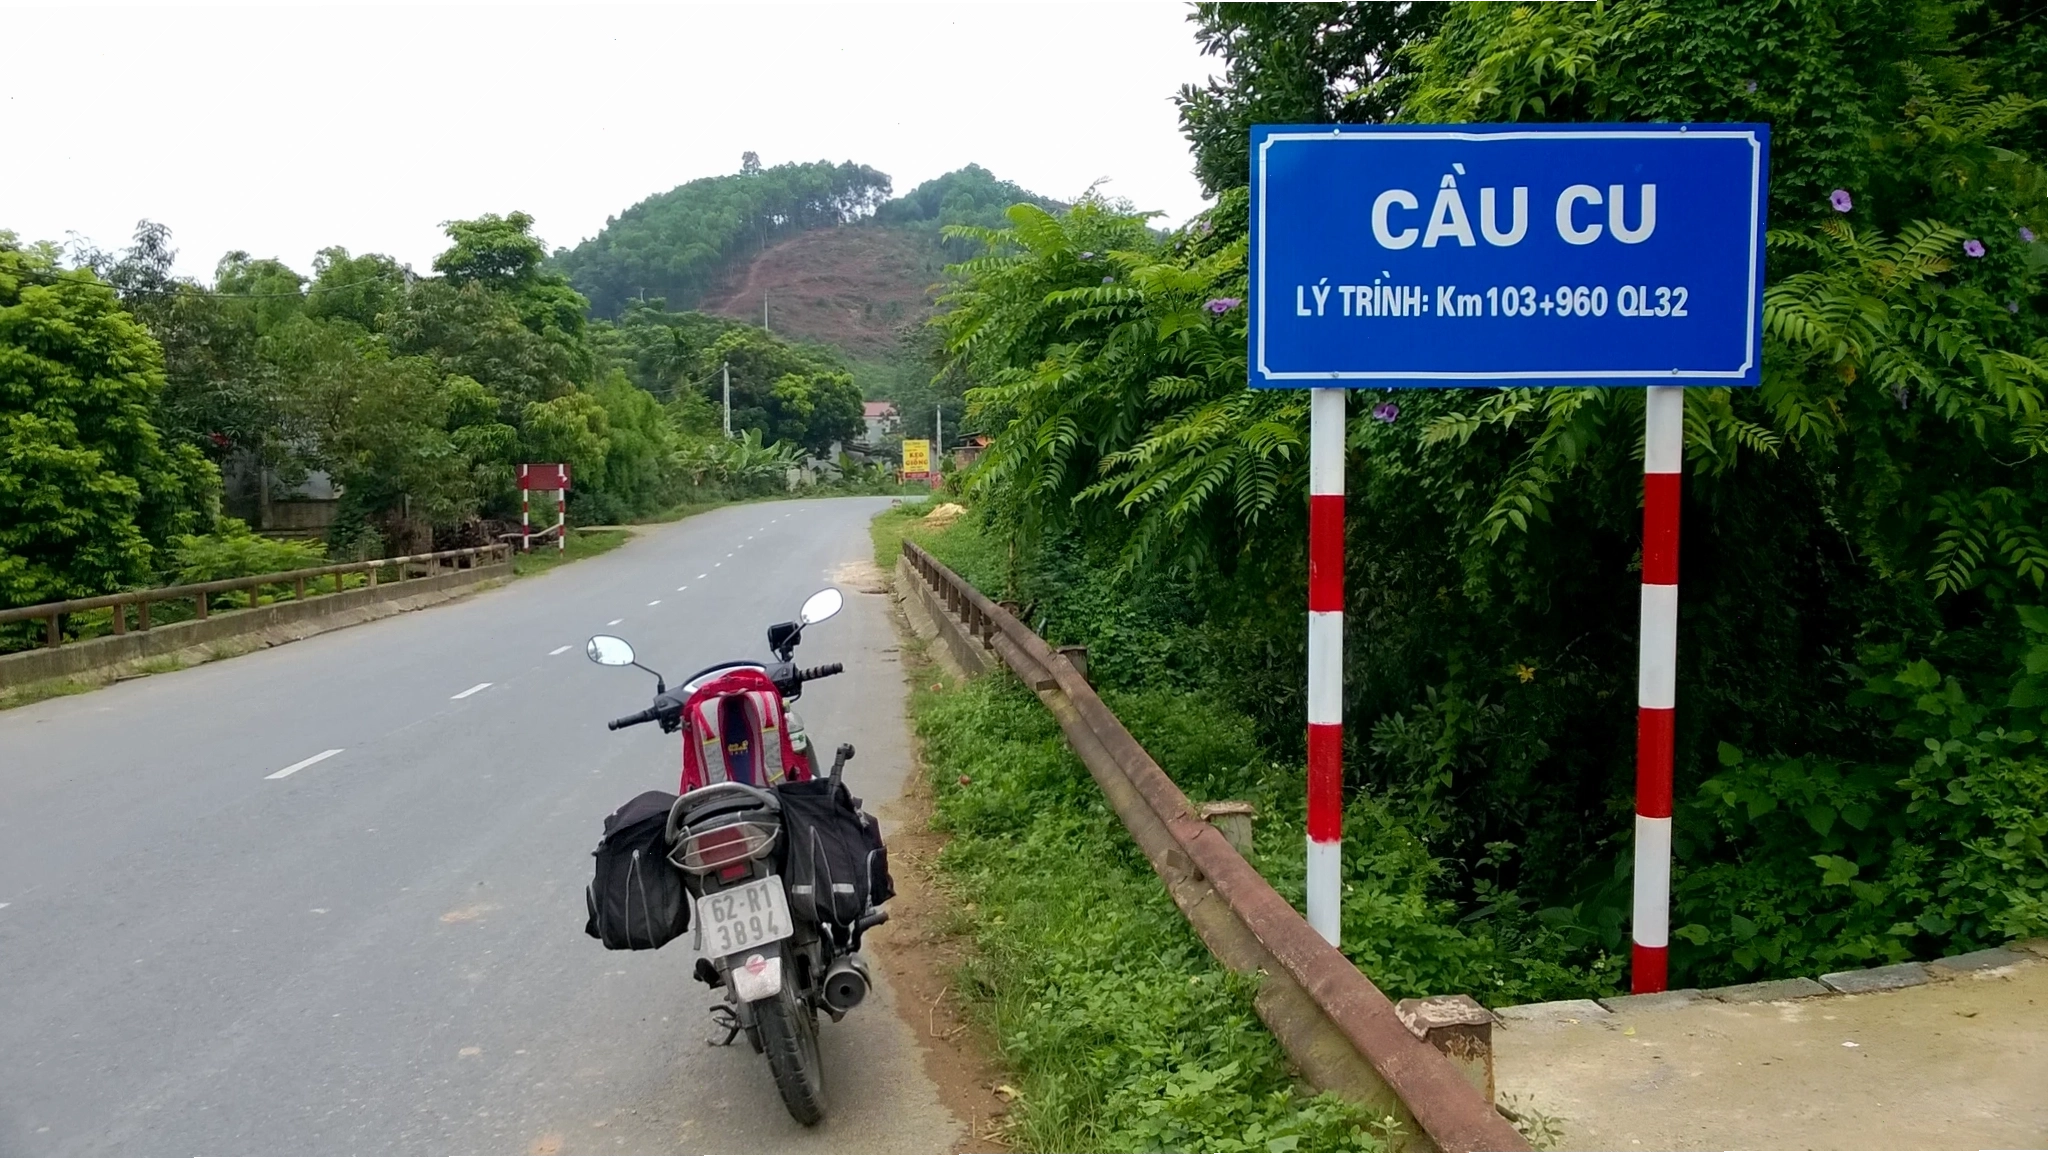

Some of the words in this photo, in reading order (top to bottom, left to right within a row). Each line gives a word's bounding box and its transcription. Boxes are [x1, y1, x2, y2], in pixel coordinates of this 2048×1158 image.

[1371, 163, 1528, 250] CẦU
[1555, 183, 1656, 245] CU
[1297, 277, 1331, 316] LÝ
[1338, 270, 1429, 317] TRÌNH:
[1617, 285, 1688, 317] QL32
[711, 883, 773, 924] 62-R1
[717, 911, 779, 950] 3894
